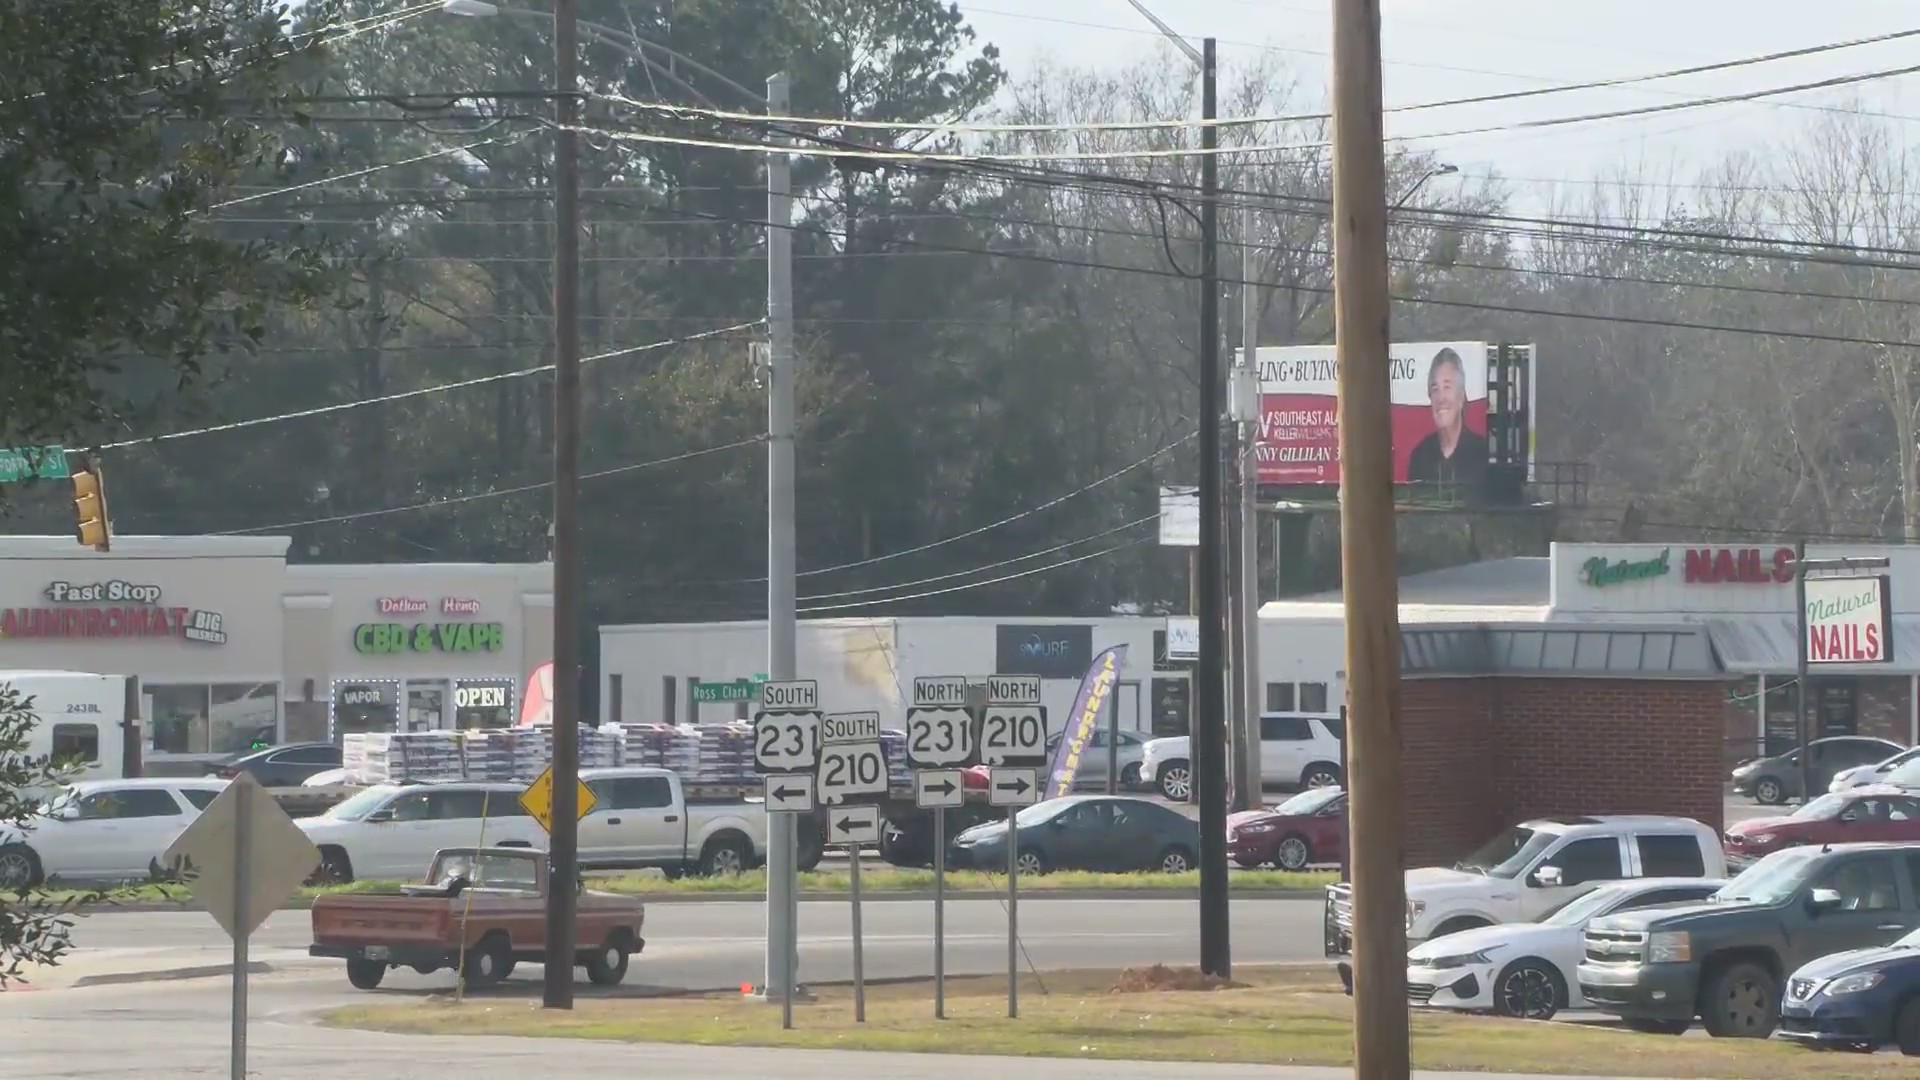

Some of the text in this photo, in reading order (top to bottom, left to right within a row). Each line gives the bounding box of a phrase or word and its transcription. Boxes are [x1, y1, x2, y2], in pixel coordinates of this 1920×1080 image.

[1389, 358, 1416, 380] ING
[1274, 410, 1322, 426] SOUTHEAST
[1324, 410, 1339, 425] AL
[1684, 548, 1798, 584] NAILS
[45, 580, 161, 603] Fast Stop
[1807, 581, 1877, 622] Natural
[380, 599, 480, 613] Dothan Hemp
[194, 611, 222, 630] BIG
[355, 623, 504, 654] CBD & VAPE
[1810, 623, 1879, 660] NAILS
[344, 691, 380, 704] VAPOR
[456, 687, 505, 707] OPEN
[694, 686, 716, 700] Ross
[722, 686, 748, 699] Clark
[765, 686, 814, 705] SOUTH
[917, 682, 964, 701] NORTH
[990, 680, 1038, 699] NORTH
[824, 719, 876, 738] SOUTH
[913, 720, 968, 753] 231
[988, 715, 1039, 748] 210
[760, 724, 817, 757] 231
[824, 752, 880, 787] 210
